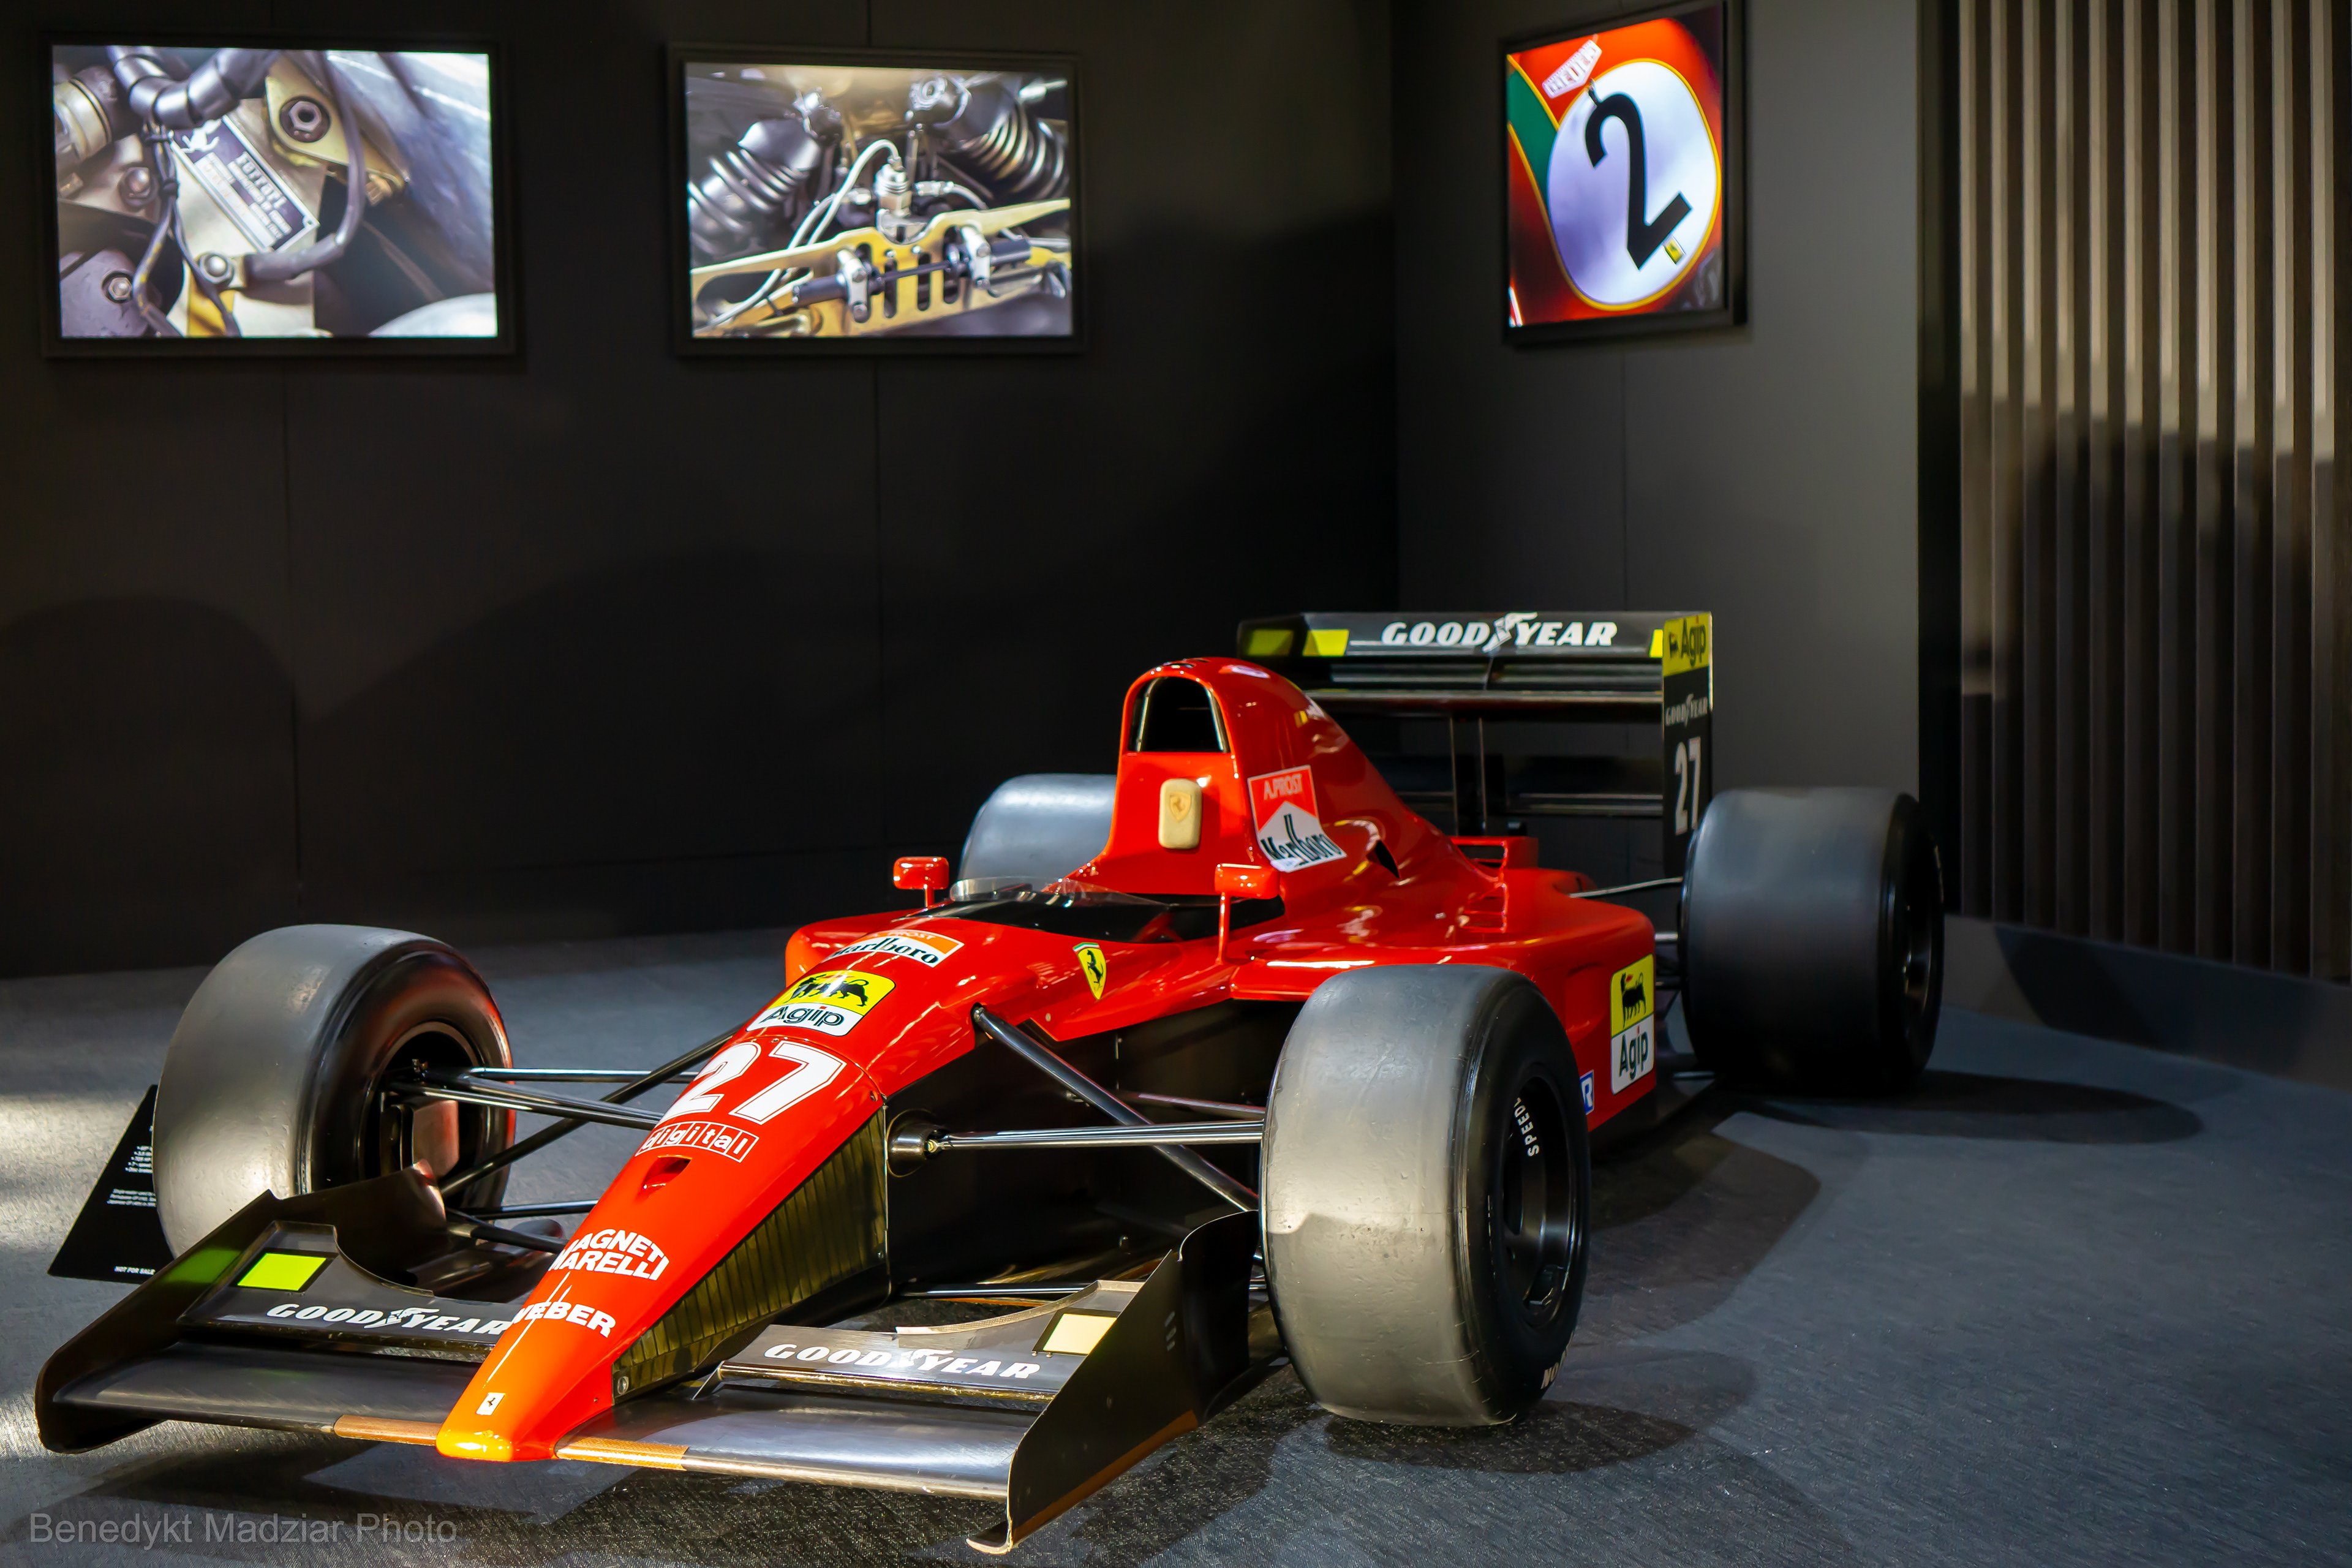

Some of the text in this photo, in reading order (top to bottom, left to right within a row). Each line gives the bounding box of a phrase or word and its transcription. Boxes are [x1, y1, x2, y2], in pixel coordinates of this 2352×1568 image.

[1585, 92, 1692, 271] 2
[1681, 616, 1706, 667] Agip
[1675, 736, 1701, 835] 27
[1261, 814, 1342, 866] Marlboro
[759, 1005, 845, 1027] Agip
[1619, 1025, 1648, 1080] Agip
[654, 1040, 847, 1129] 27
[642, 1126, 748, 1155] digital
